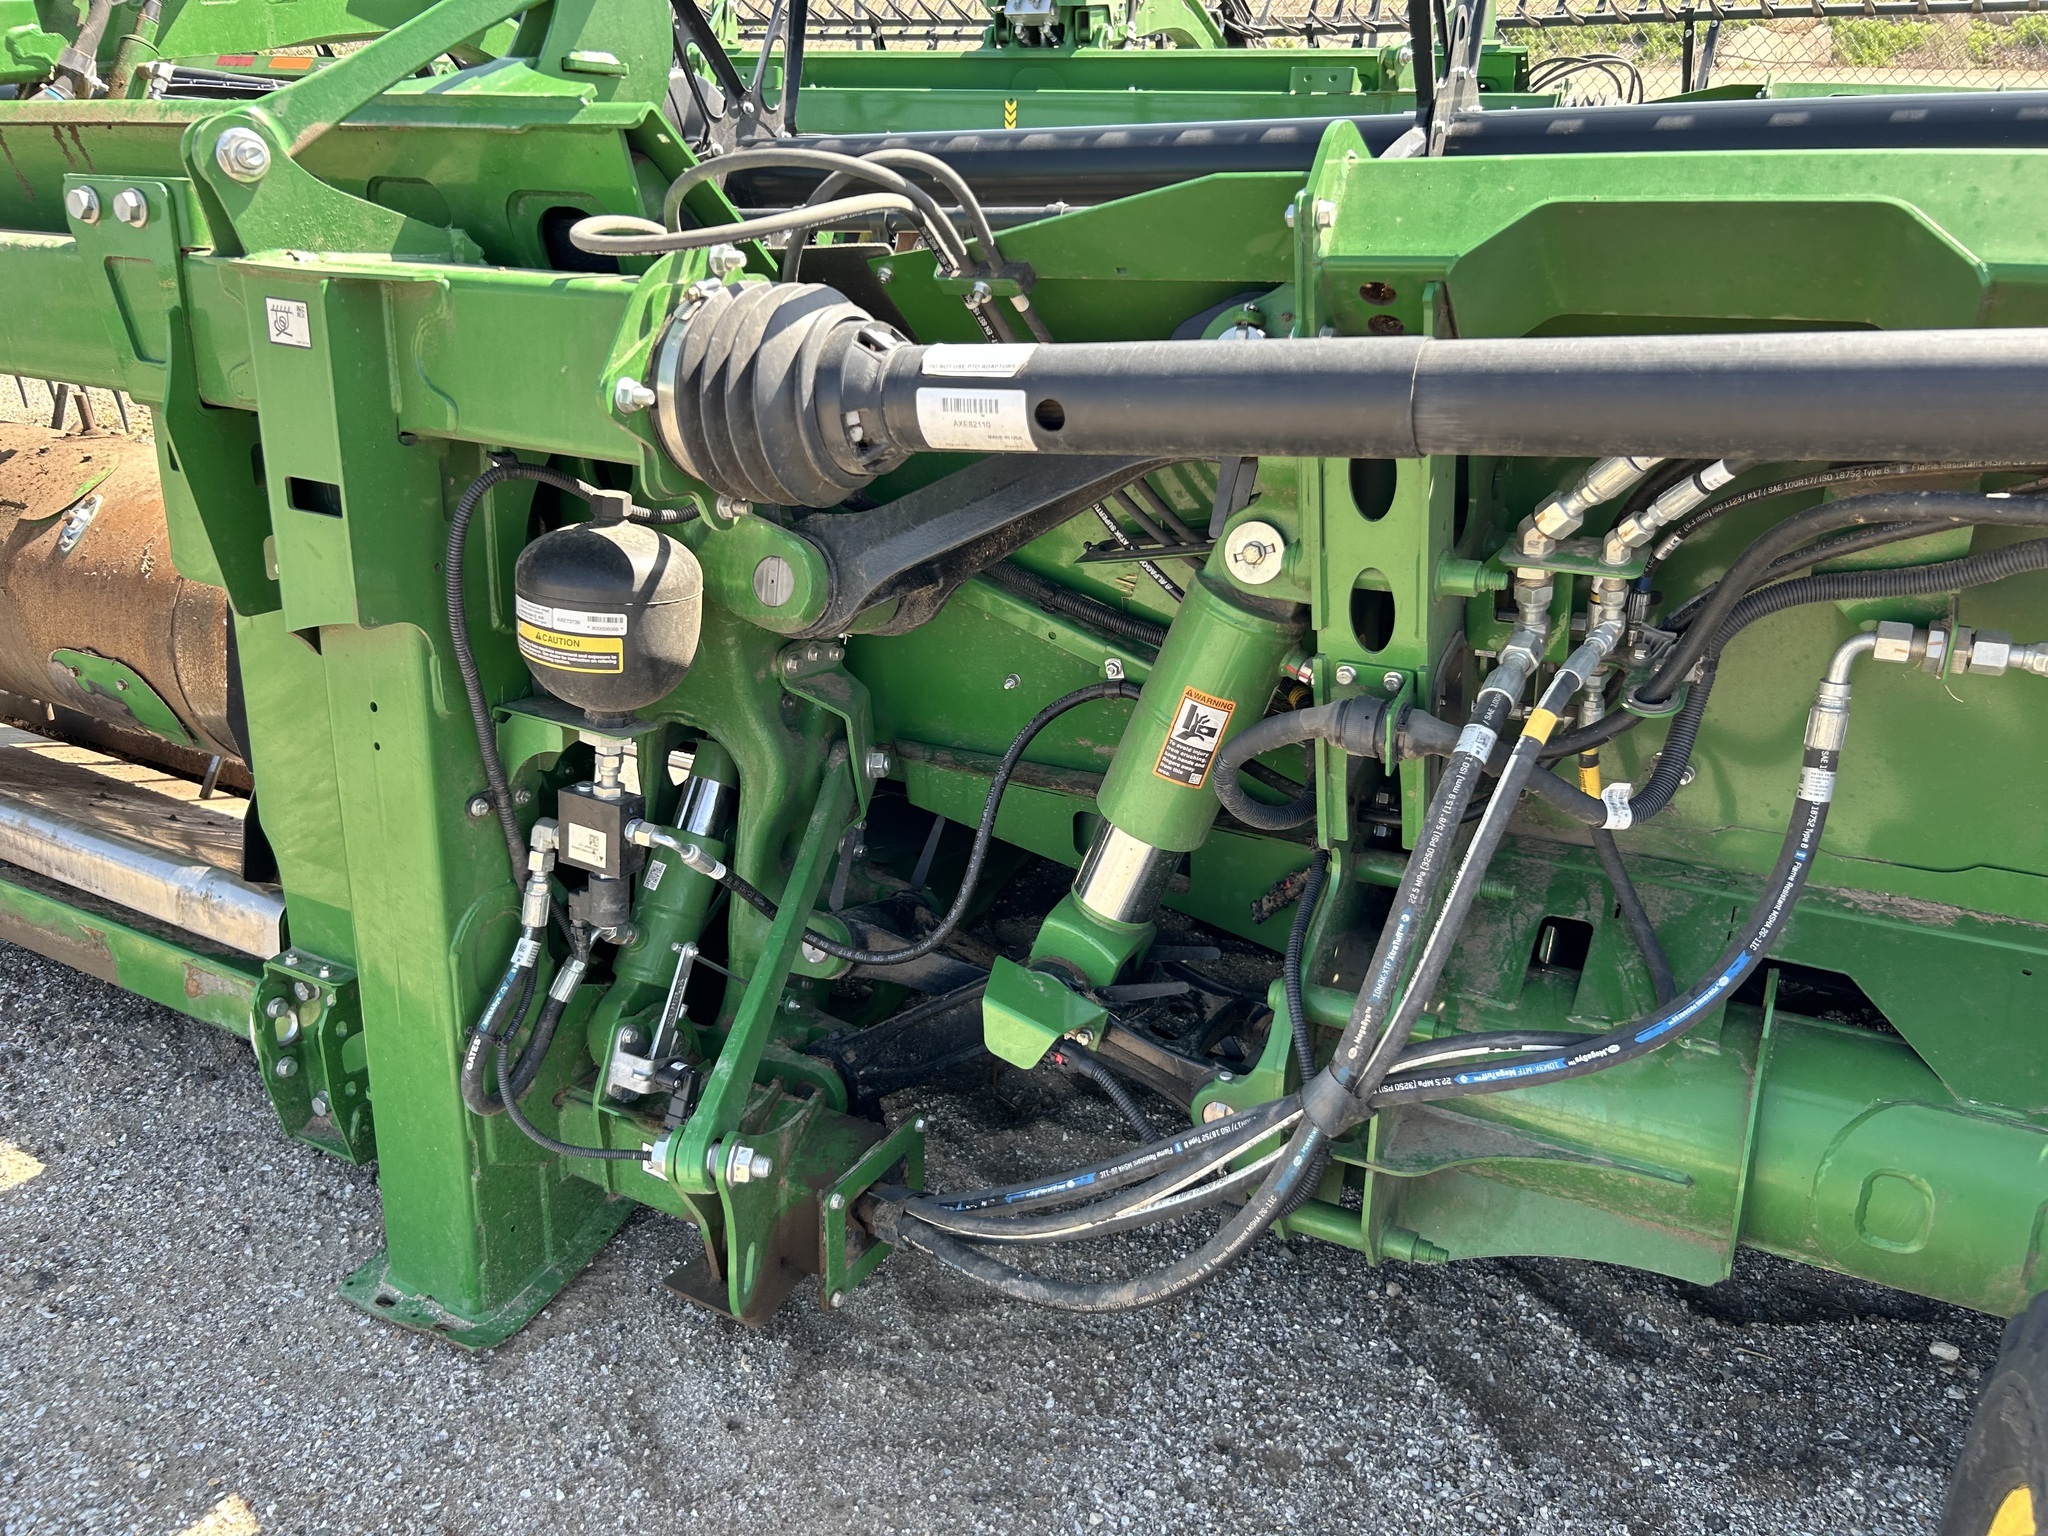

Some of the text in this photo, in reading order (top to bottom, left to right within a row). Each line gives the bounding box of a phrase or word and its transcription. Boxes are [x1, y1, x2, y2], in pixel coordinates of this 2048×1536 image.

[1725, 495, 1746, 508] 11237
[1747, 491, 1761, 500] R17
[1768, 484, 1782, 494] SAE
[1819, 472, 1832, 482] ISO
[1864, 468, 1882, 476] Type
[542, 634, 580, 647] CAUTION
[1194, 692, 1233, 710] WARNING
[1484, 707, 1495, 721] SAE
[1167, 746, 1178, 754] from
[1177, 742, 1192, 752] avoid
[1193, 748, 1209, 757] injury
[1820, 751, 1829, 763] SAE
[1160, 762, 1172, 770] from
[1162, 757, 1195, 772] fingers away
[1165, 752, 1176, 760] keep
[1178, 756, 1193, 765] hands
[1415, 871, 1428, 887] MPa
[1459, 760, 1470, 776] ISO
[1808, 805, 1819, 828] 18752
[1800, 828, 1813, 844] Type
[1787, 862, 1802, 881] Flame
[1773, 881, 1794, 910] Resistant
[1763, 908, 1780, 928] MSHA
[466, 1037, 481, 1071] GATES
[1516, 1061, 1559, 1079] 10M3K-MTF
[1418, 1078, 1434, 1088] MPa
[1436, 1077, 1452, 1086] 22.5
[1201, 1129, 1220, 1142] 18752
[1156, 1147, 1173, 1158] Flame
[1118, 1161, 1133, 1173] MSHA
[1133, 1153, 1157, 1168] Resistant
[1210, 1250, 1228, 1266] Flame
[1225, 1231, 1249, 1255] Resistant
[1247, 1213, 1262, 1233] MSHA
